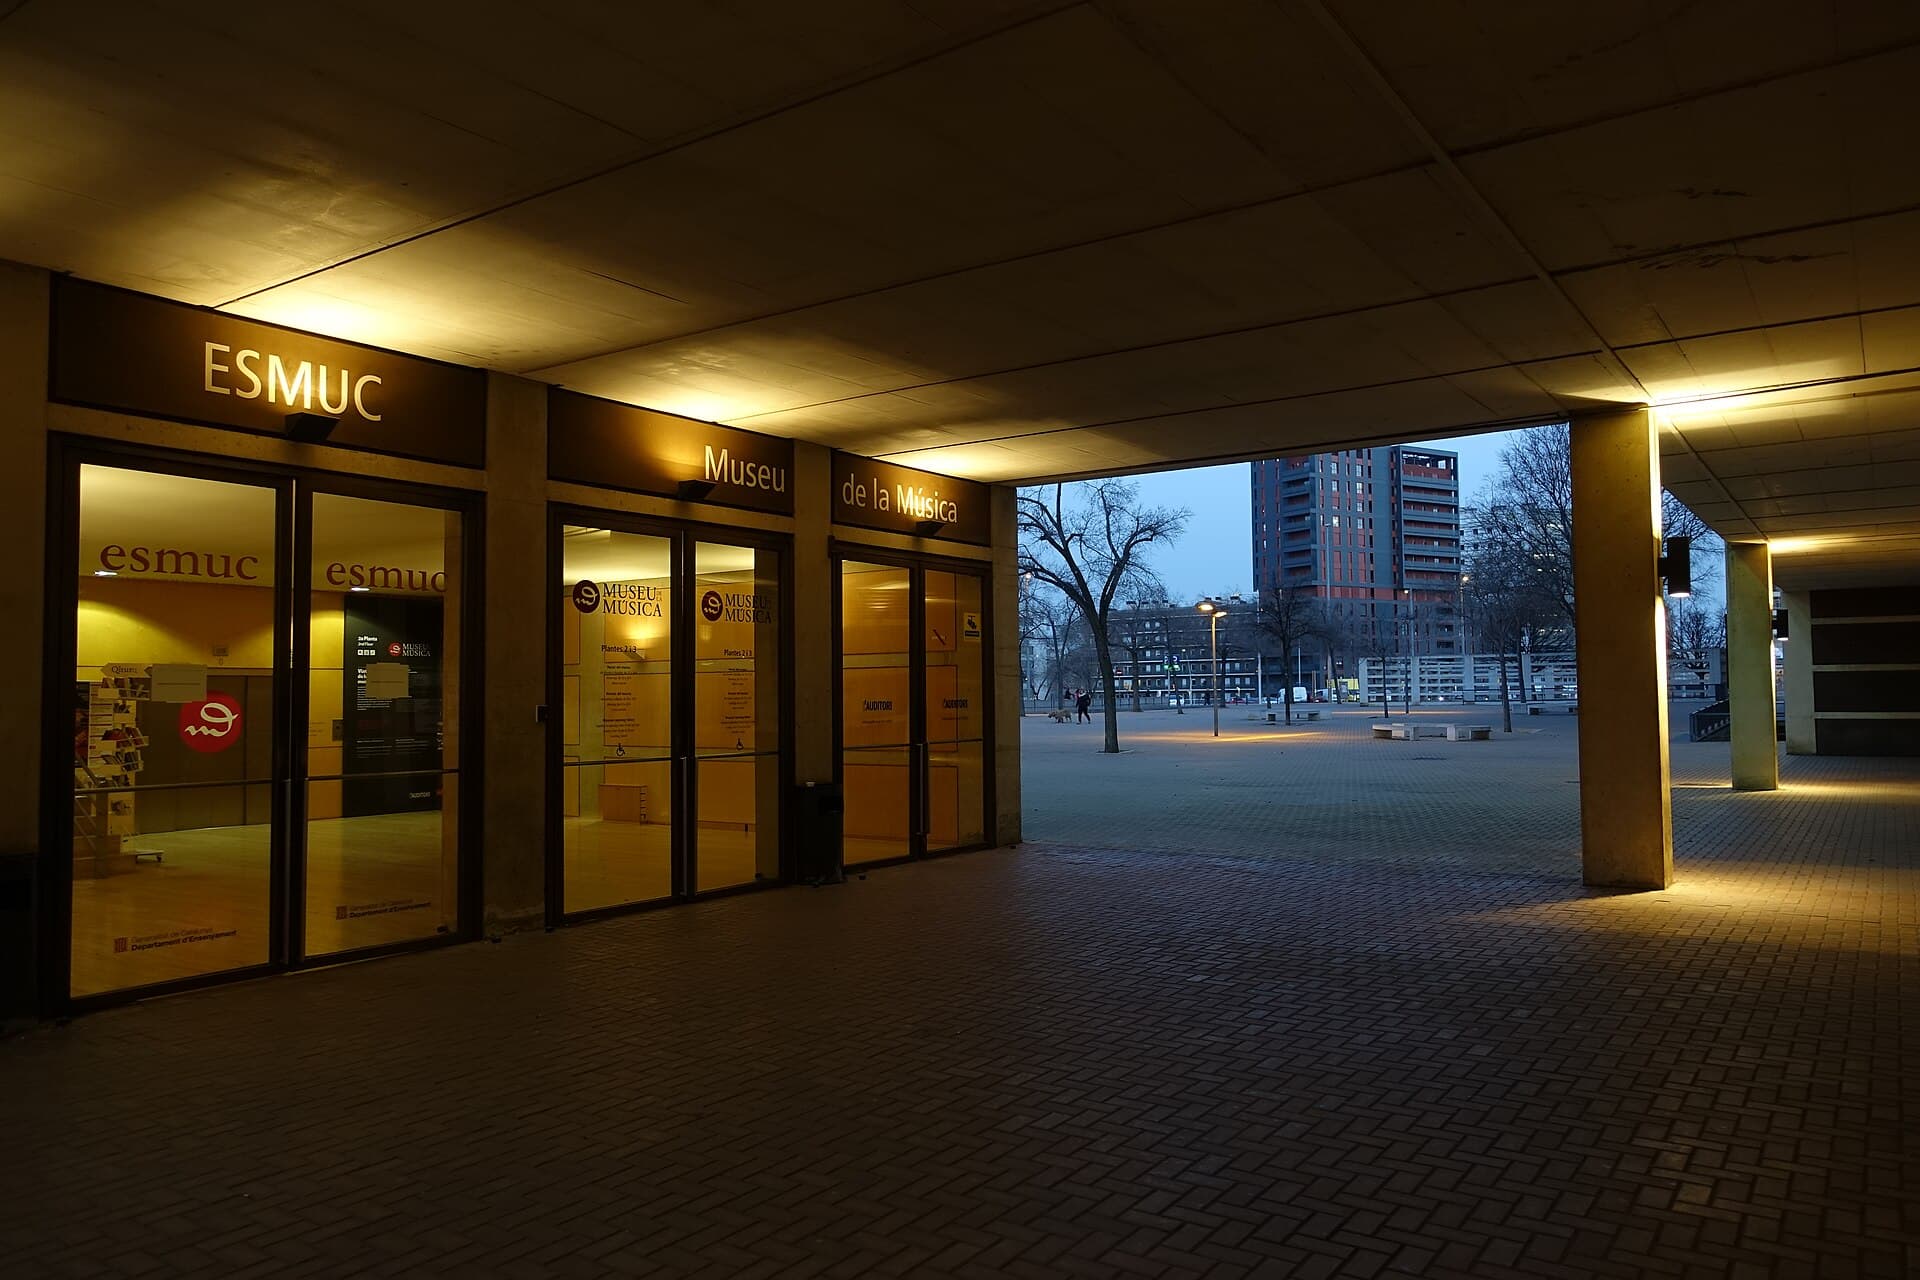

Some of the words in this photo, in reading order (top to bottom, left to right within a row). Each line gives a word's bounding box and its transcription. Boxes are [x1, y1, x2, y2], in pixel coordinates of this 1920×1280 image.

[205, 341, 382, 421] ESMUC
[704, 445, 785, 493] Museu
[842, 473, 867, 507] de
[873, 477, 890, 511] la
[896, 484, 958, 523] Música
[100, 544, 259, 580] esmuc
[326, 562, 448, 593] esmuc
[602, 582, 656, 601] MUSEU
[602, 599, 662, 617] MÚSICA
[725, 593, 768, 609] MUSEU
[725, 607, 772, 624] MÚSICA
[601, 644, 623, 653] Plantes
[632, 645, 637, 653] 3
[723, 649, 742, 657] Plantes
[131, 938, 181, 951] Departament
